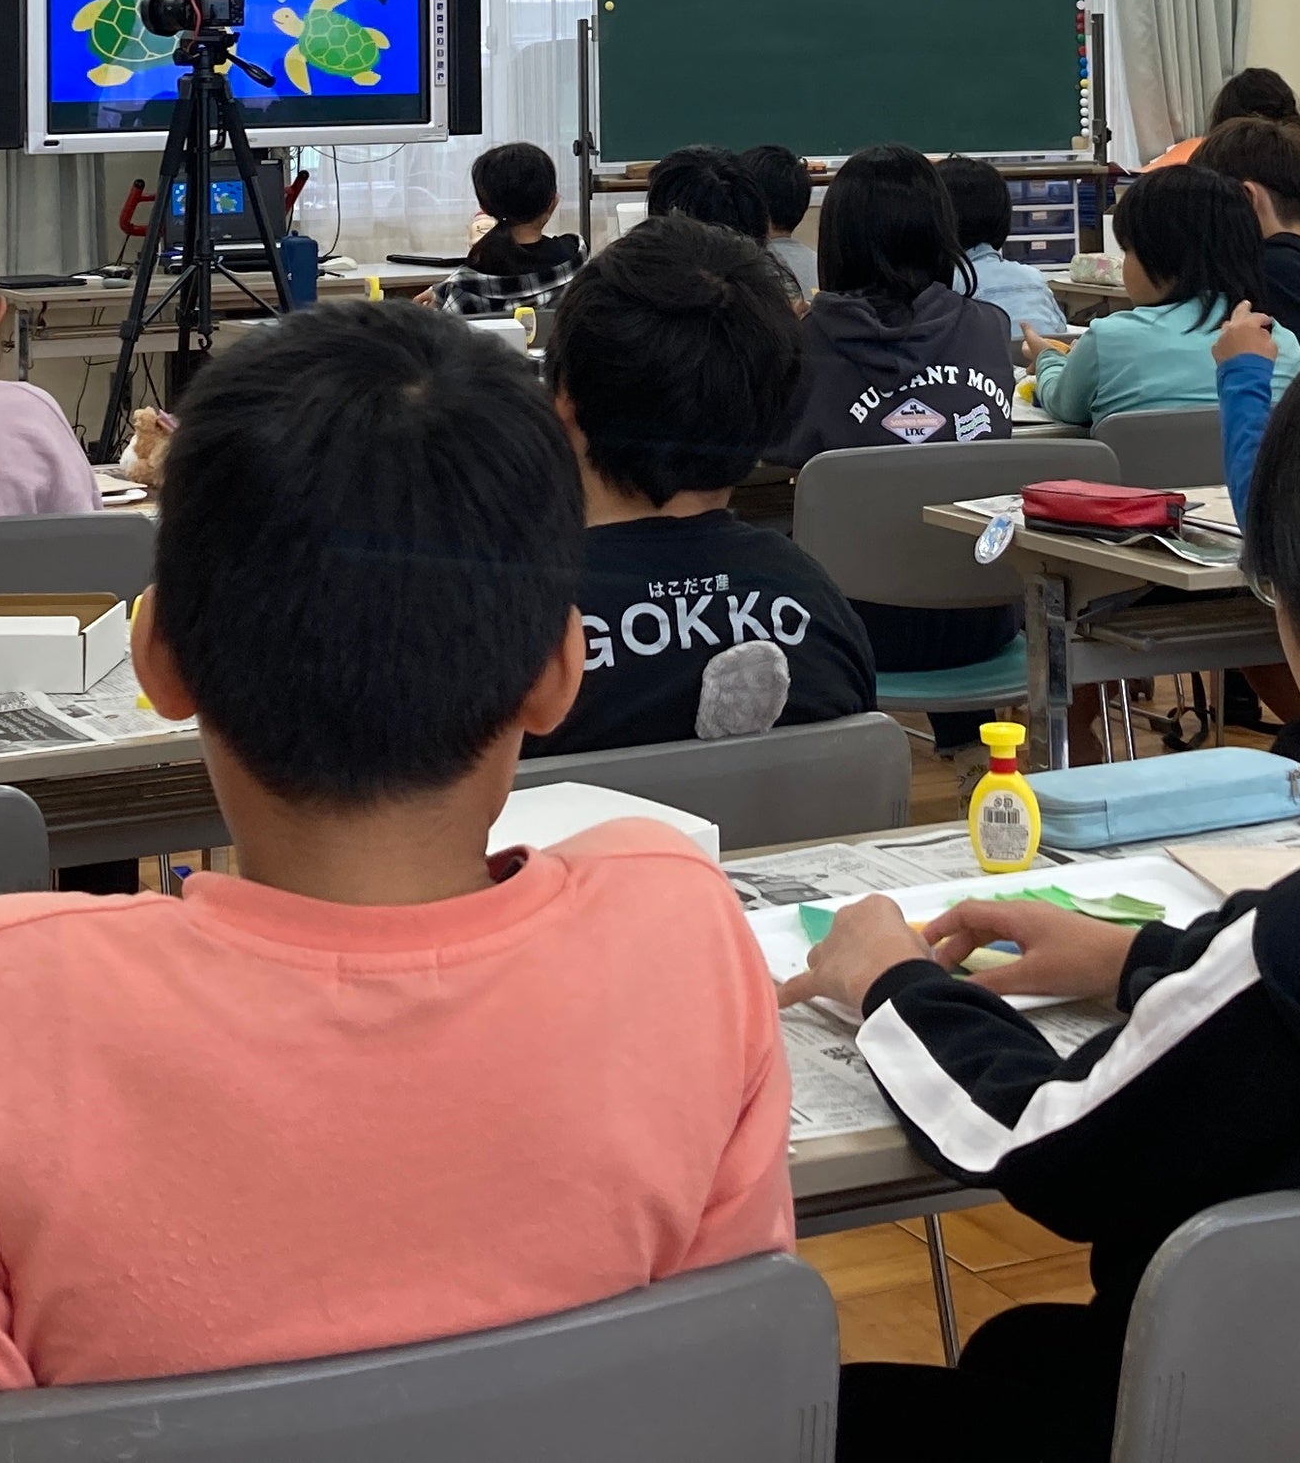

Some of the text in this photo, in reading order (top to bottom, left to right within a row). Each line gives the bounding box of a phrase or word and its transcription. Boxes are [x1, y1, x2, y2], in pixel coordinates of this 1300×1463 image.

[850, 365, 1012, 424] BUANT MOOD
[649, 574, 729, 599] はこだて産
[581, 591, 811, 671] GOKKO
